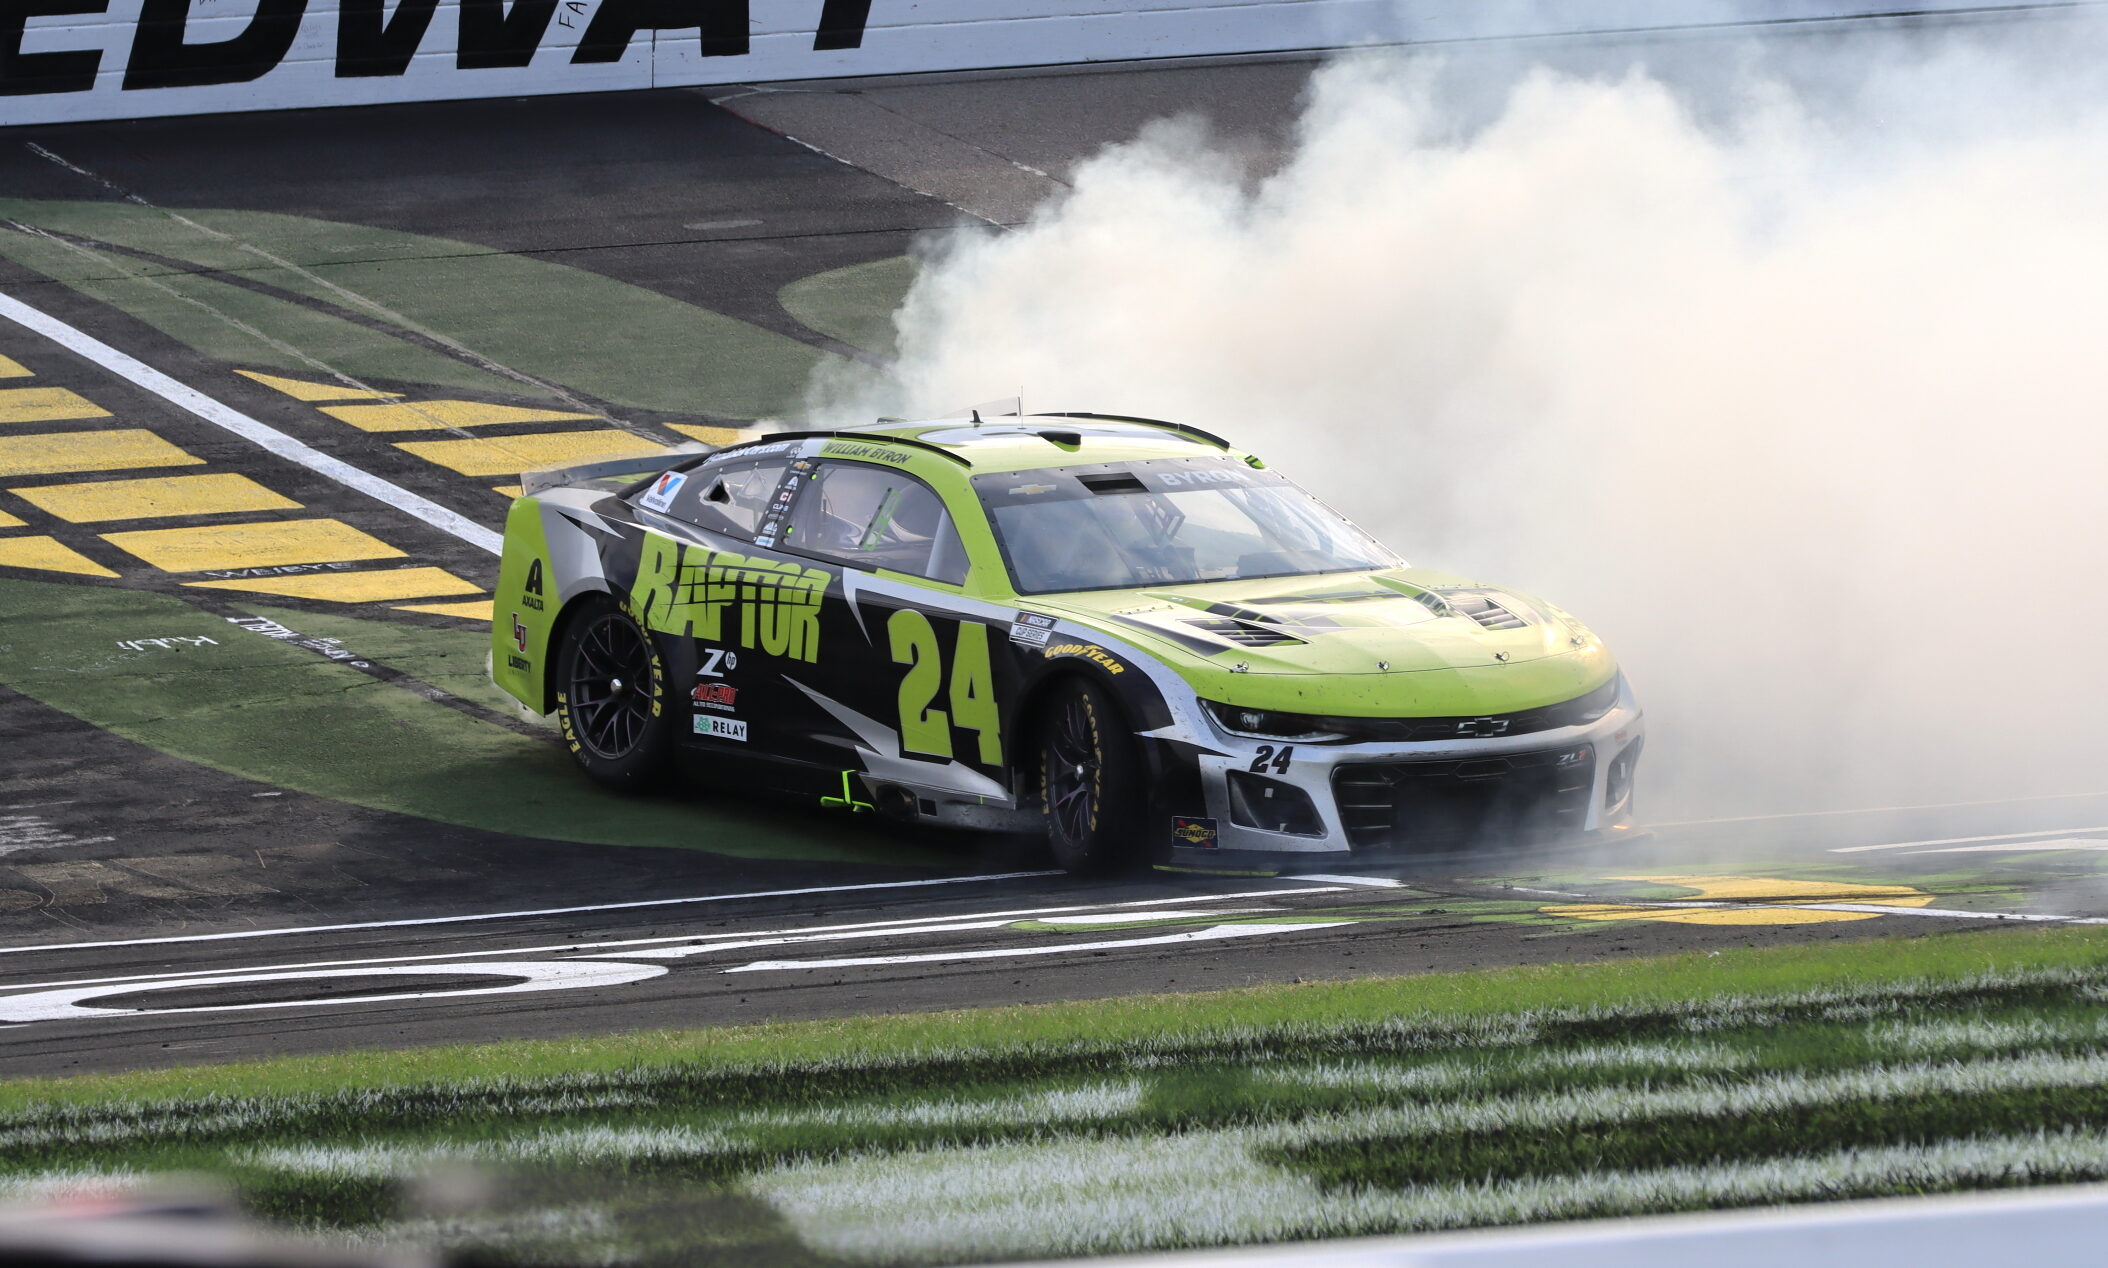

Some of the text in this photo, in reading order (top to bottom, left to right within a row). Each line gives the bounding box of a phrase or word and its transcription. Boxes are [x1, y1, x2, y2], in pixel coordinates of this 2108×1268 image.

[822, 442, 869, 458] WILLIAM
[871, 448, 912, 464] BYRON
[1157, 469, 1249, 487] BYRON
[521, 594, 544, 613] AXALTA
[630, 531, 831, 664] RAPTOR
[508, 654, 532, 674] LIBERTY
[696, 648, 726, 678] Z
[726, 651, 737, 671] hp
[1044, 644, 1125, 676] GOODYEAR
[887, 607, 1004, 768] 24
[557, 690, 582, 754] EAGLE
[712, 720, 745, 737] RELAY
[1249, 744, 1294, 775] 24
[1174, 826, 1217, 840] SUNOCO
